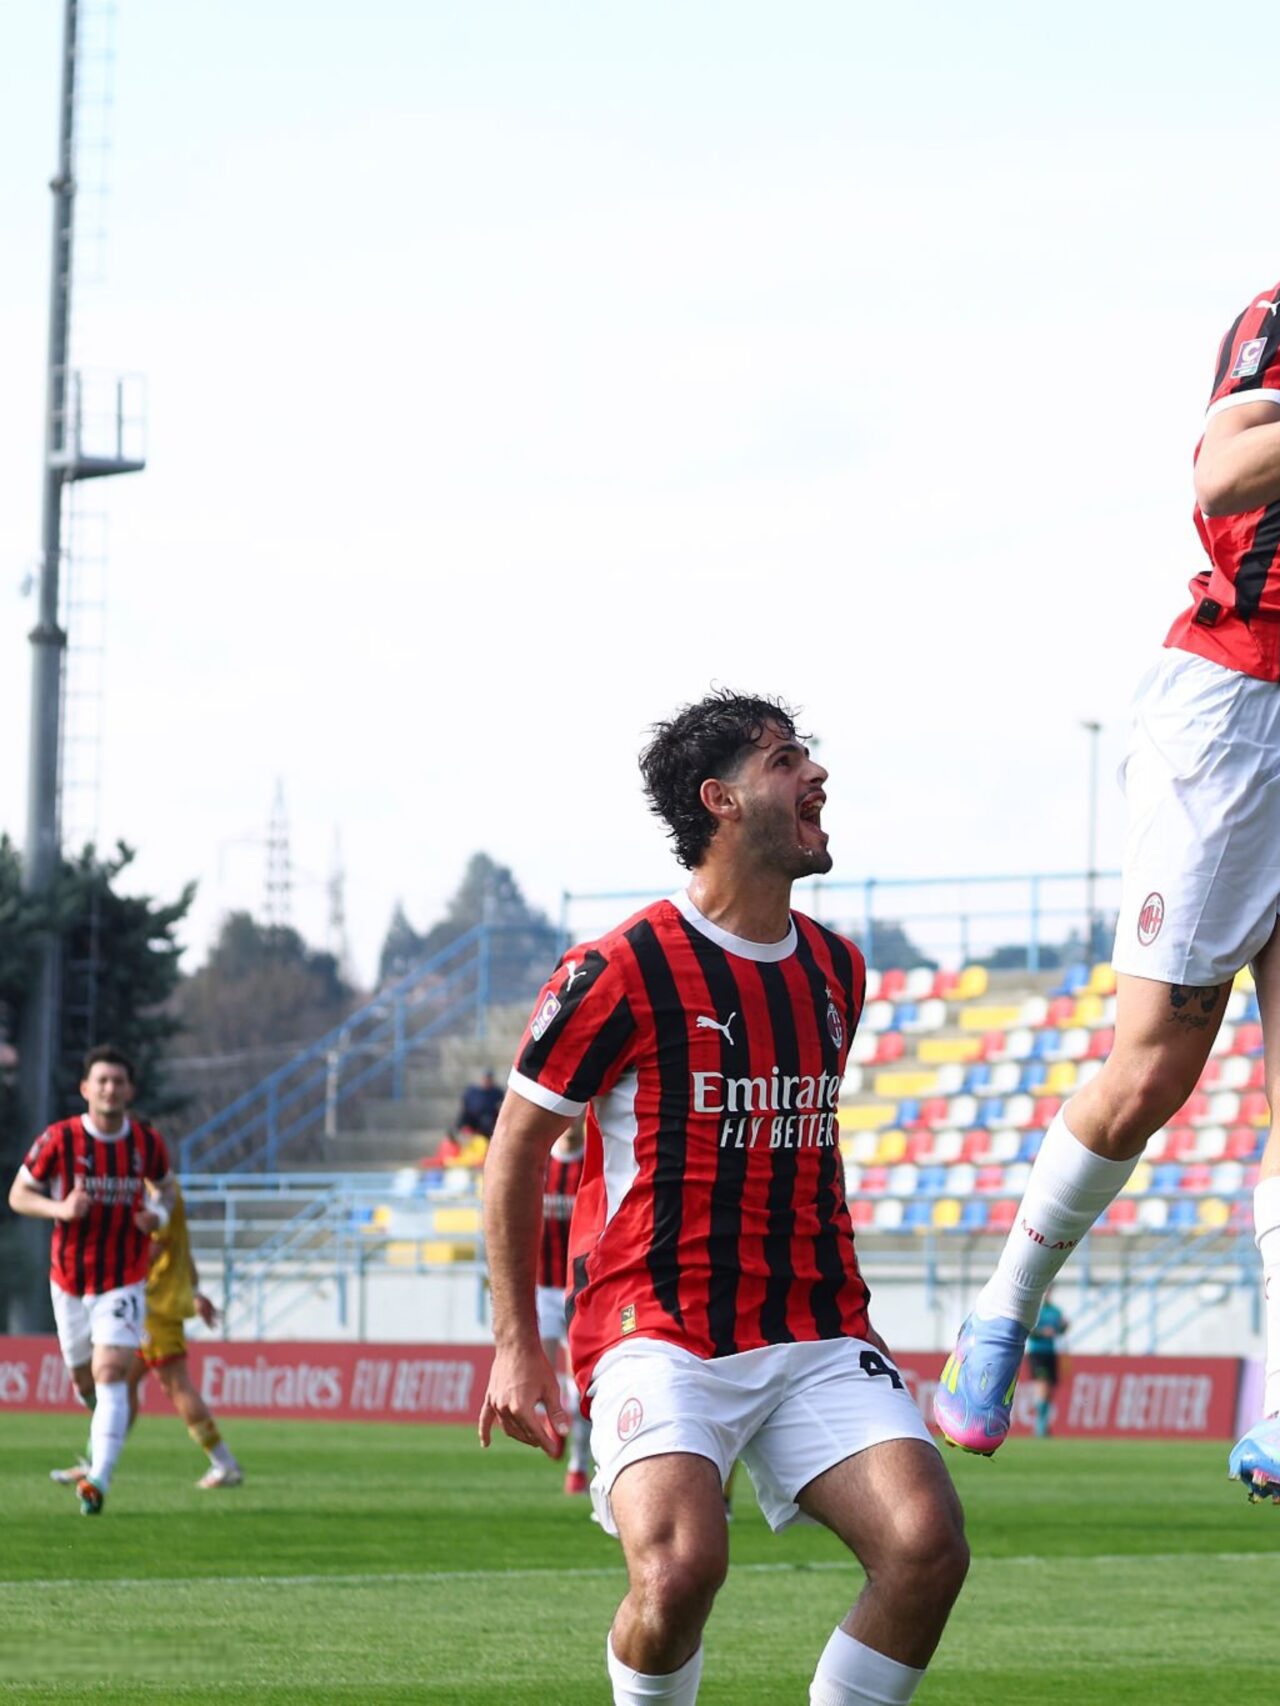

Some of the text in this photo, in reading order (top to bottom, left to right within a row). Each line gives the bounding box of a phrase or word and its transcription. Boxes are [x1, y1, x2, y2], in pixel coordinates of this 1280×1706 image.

[691, 1065, 844, 1113] Emirate
[720, 1112, 836, 1149] FLY BETTER
[202, 1356, 342, 1409] Emirates
[350, 1358, 393, 1411] FLY
[390, 1360, 474, 1413] BETTER
[860, 1351, 904, 1389] 4
[1067, 1371, 1117, 1429] FLY
[1115, 1373, 1213, 1432] BETTER
